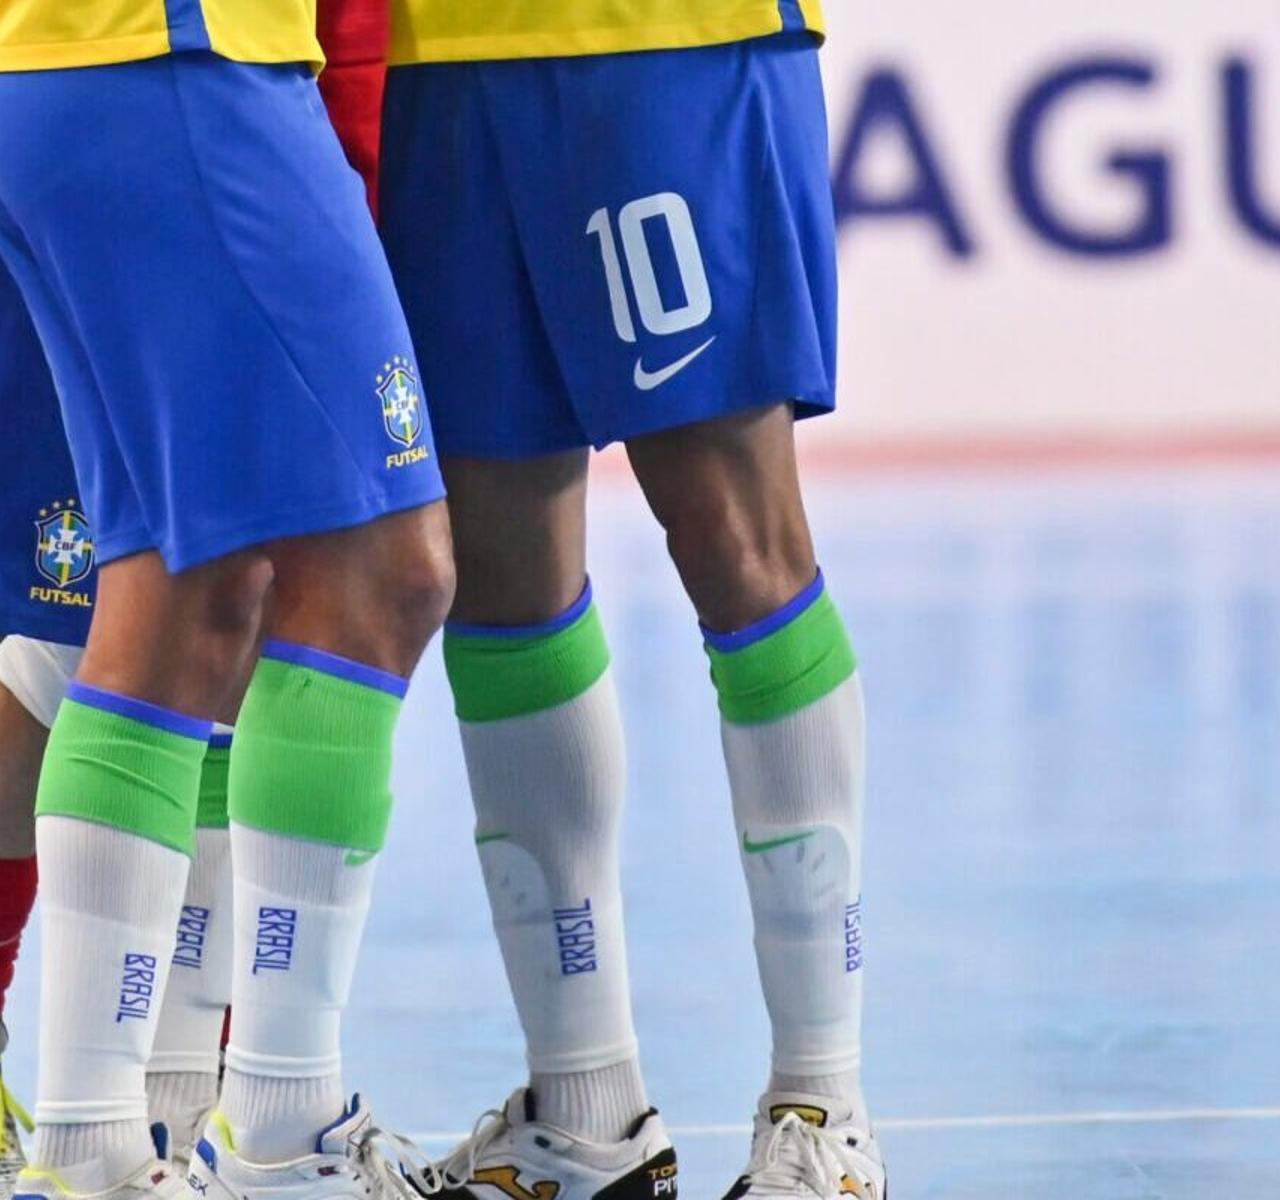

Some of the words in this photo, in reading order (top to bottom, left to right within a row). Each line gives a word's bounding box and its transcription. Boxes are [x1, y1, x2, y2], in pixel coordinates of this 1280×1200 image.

[586, 191, 714, 343] 10
[386, 444, 428, 469] FUTSAL
[30, 586, 92, 607] FUTSAL
[253, 907, 296, 974] BRASIL
[554, 898, 597, 976] BRASIL
[117, 953, 156, 1023] BRASIL
